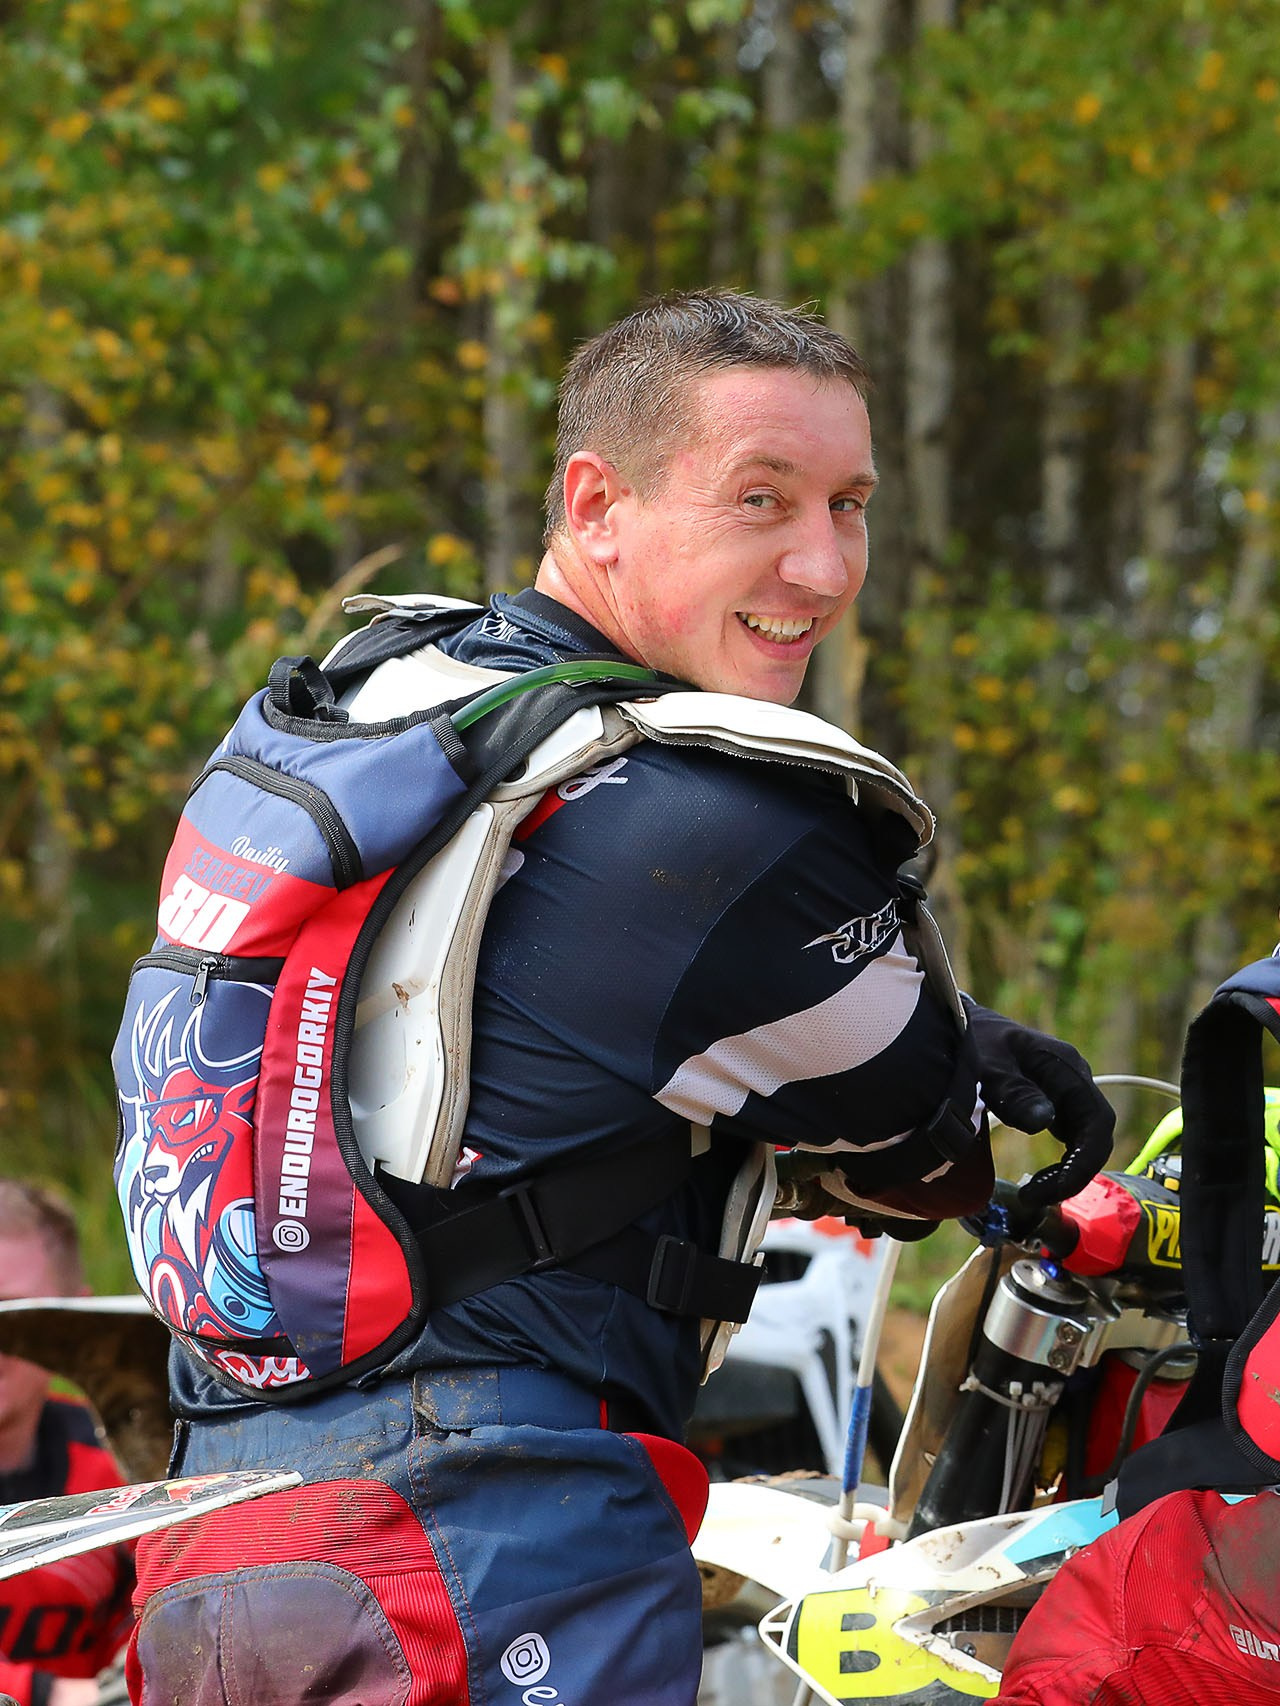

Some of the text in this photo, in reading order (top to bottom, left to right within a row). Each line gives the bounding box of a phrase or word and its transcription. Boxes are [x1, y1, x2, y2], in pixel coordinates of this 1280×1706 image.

[158, 873, 250, 953] 80
[184, 847, 273, 902] SERGEEV
[278, 967, 338, 1218] ENDUROGORKIY
